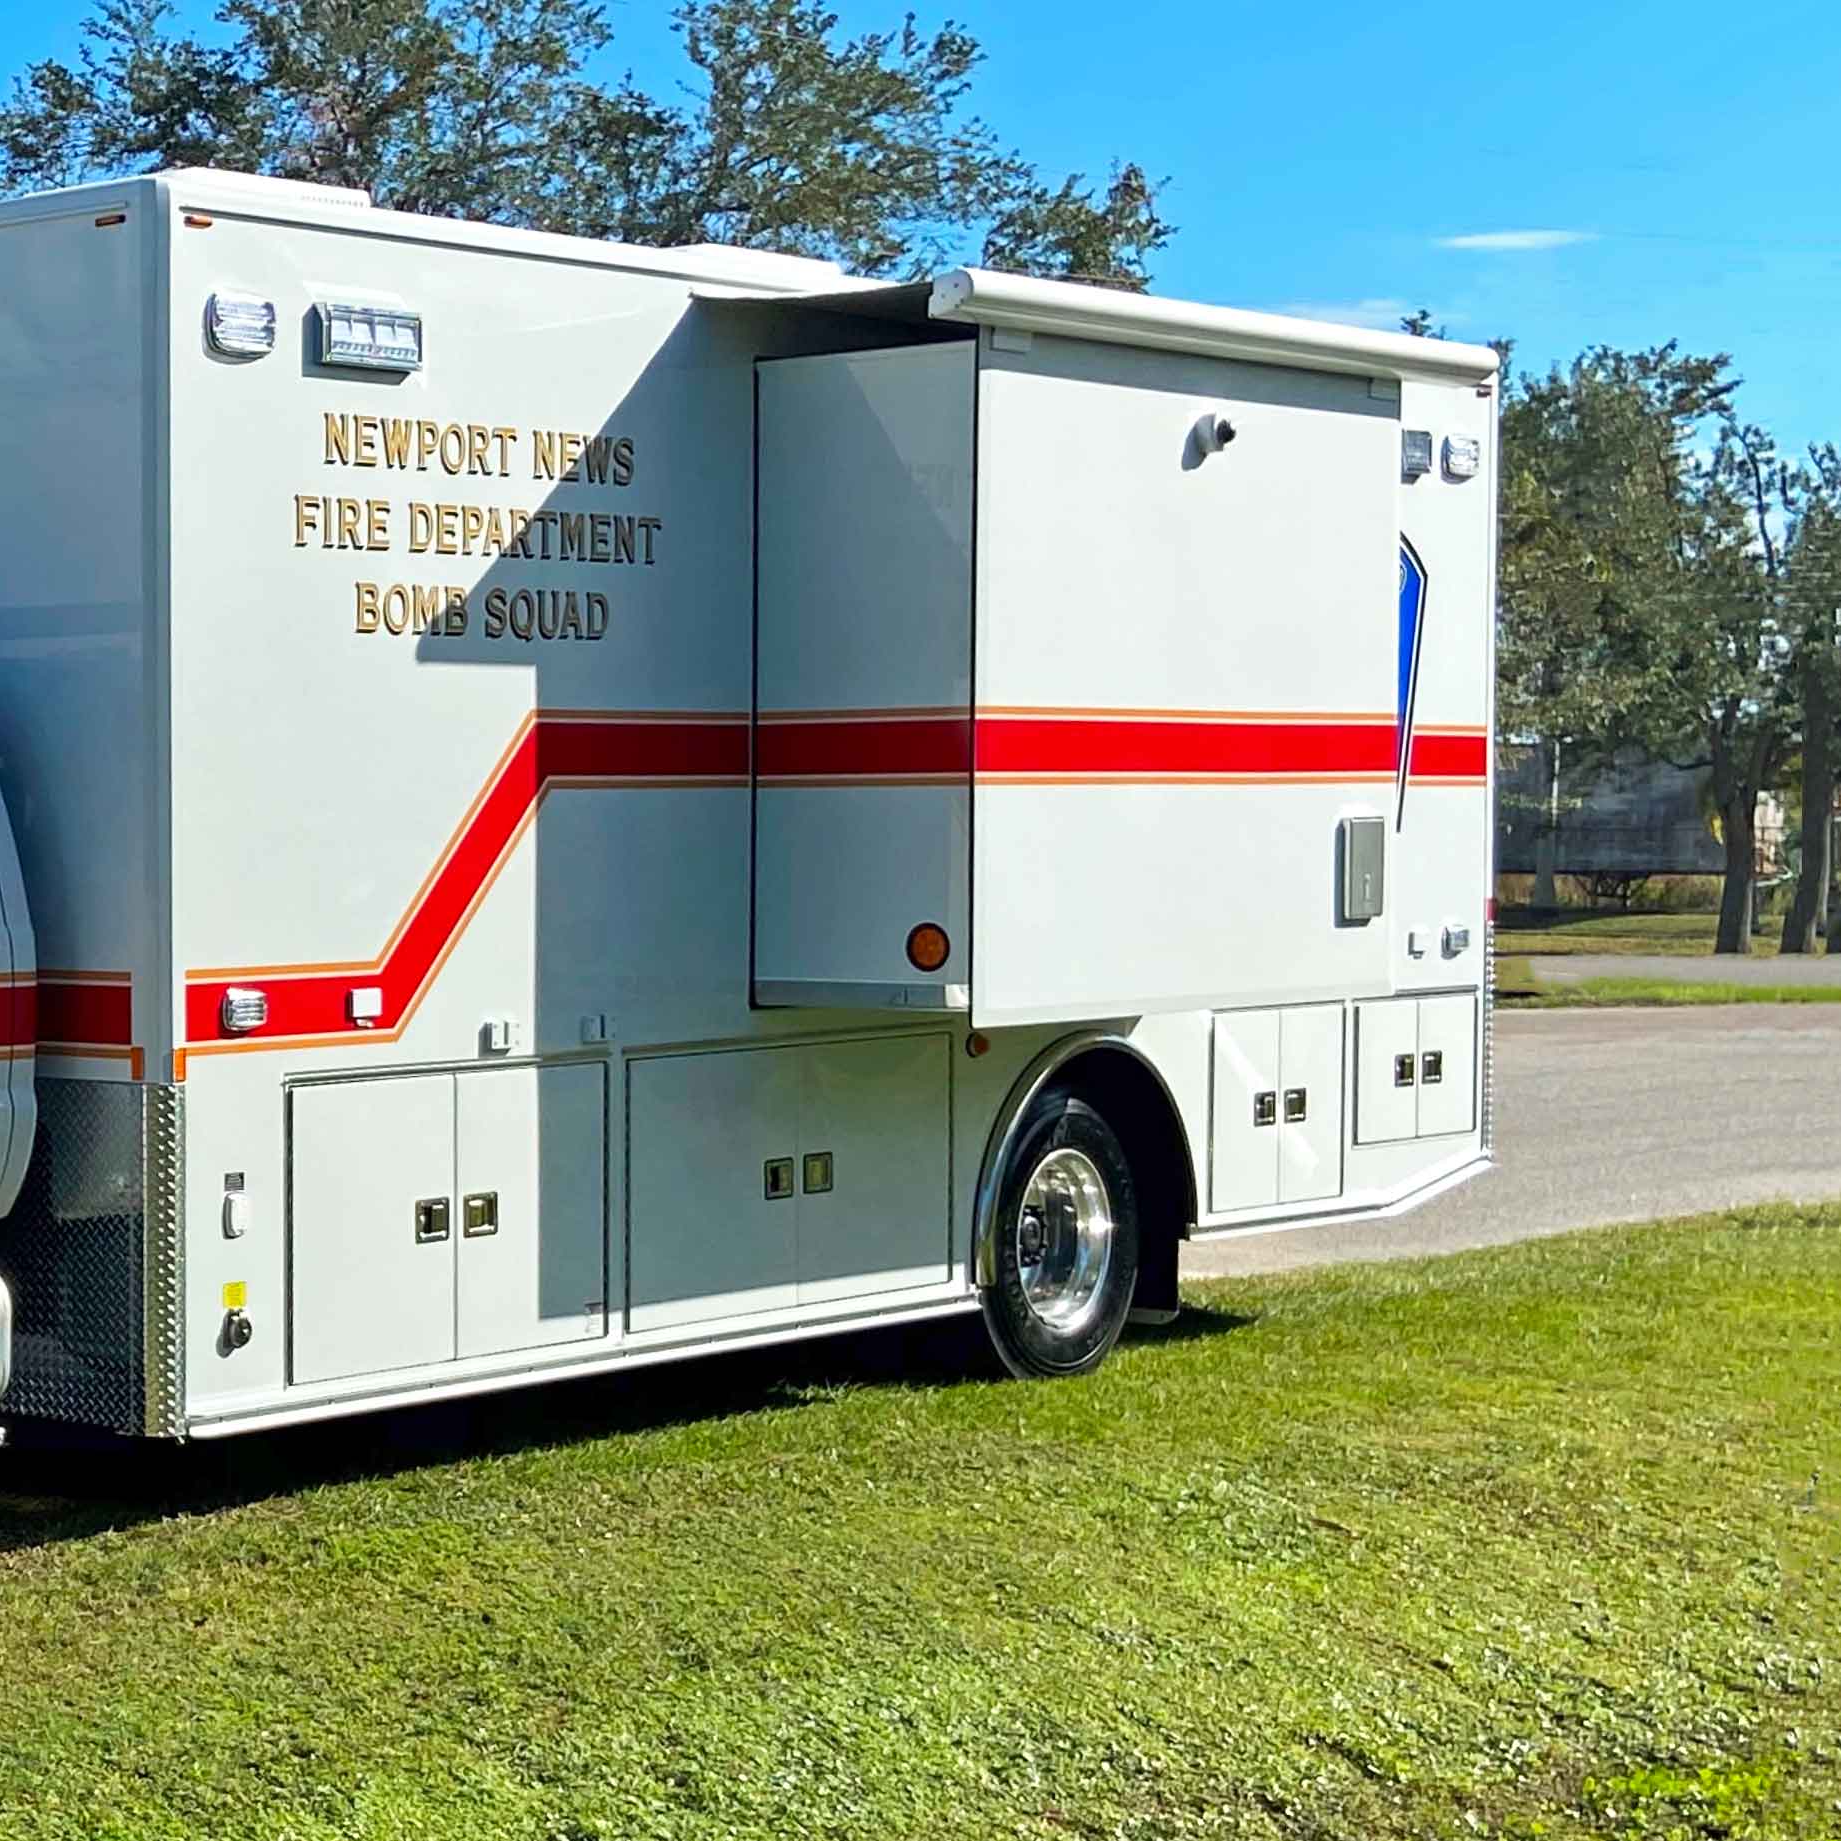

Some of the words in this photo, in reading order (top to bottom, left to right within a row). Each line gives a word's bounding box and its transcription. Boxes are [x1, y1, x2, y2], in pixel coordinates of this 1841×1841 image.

[323, 412, 517, 478] NEWPORT
[532, 429, 634, 487] NEWS
[294, 494, 390, 551] FIRE
[409, 501, 662, 565] DEPARTMENT
[355, 581, 468, 637] BOMB
[485, 587, 608, 643] SQUAD
